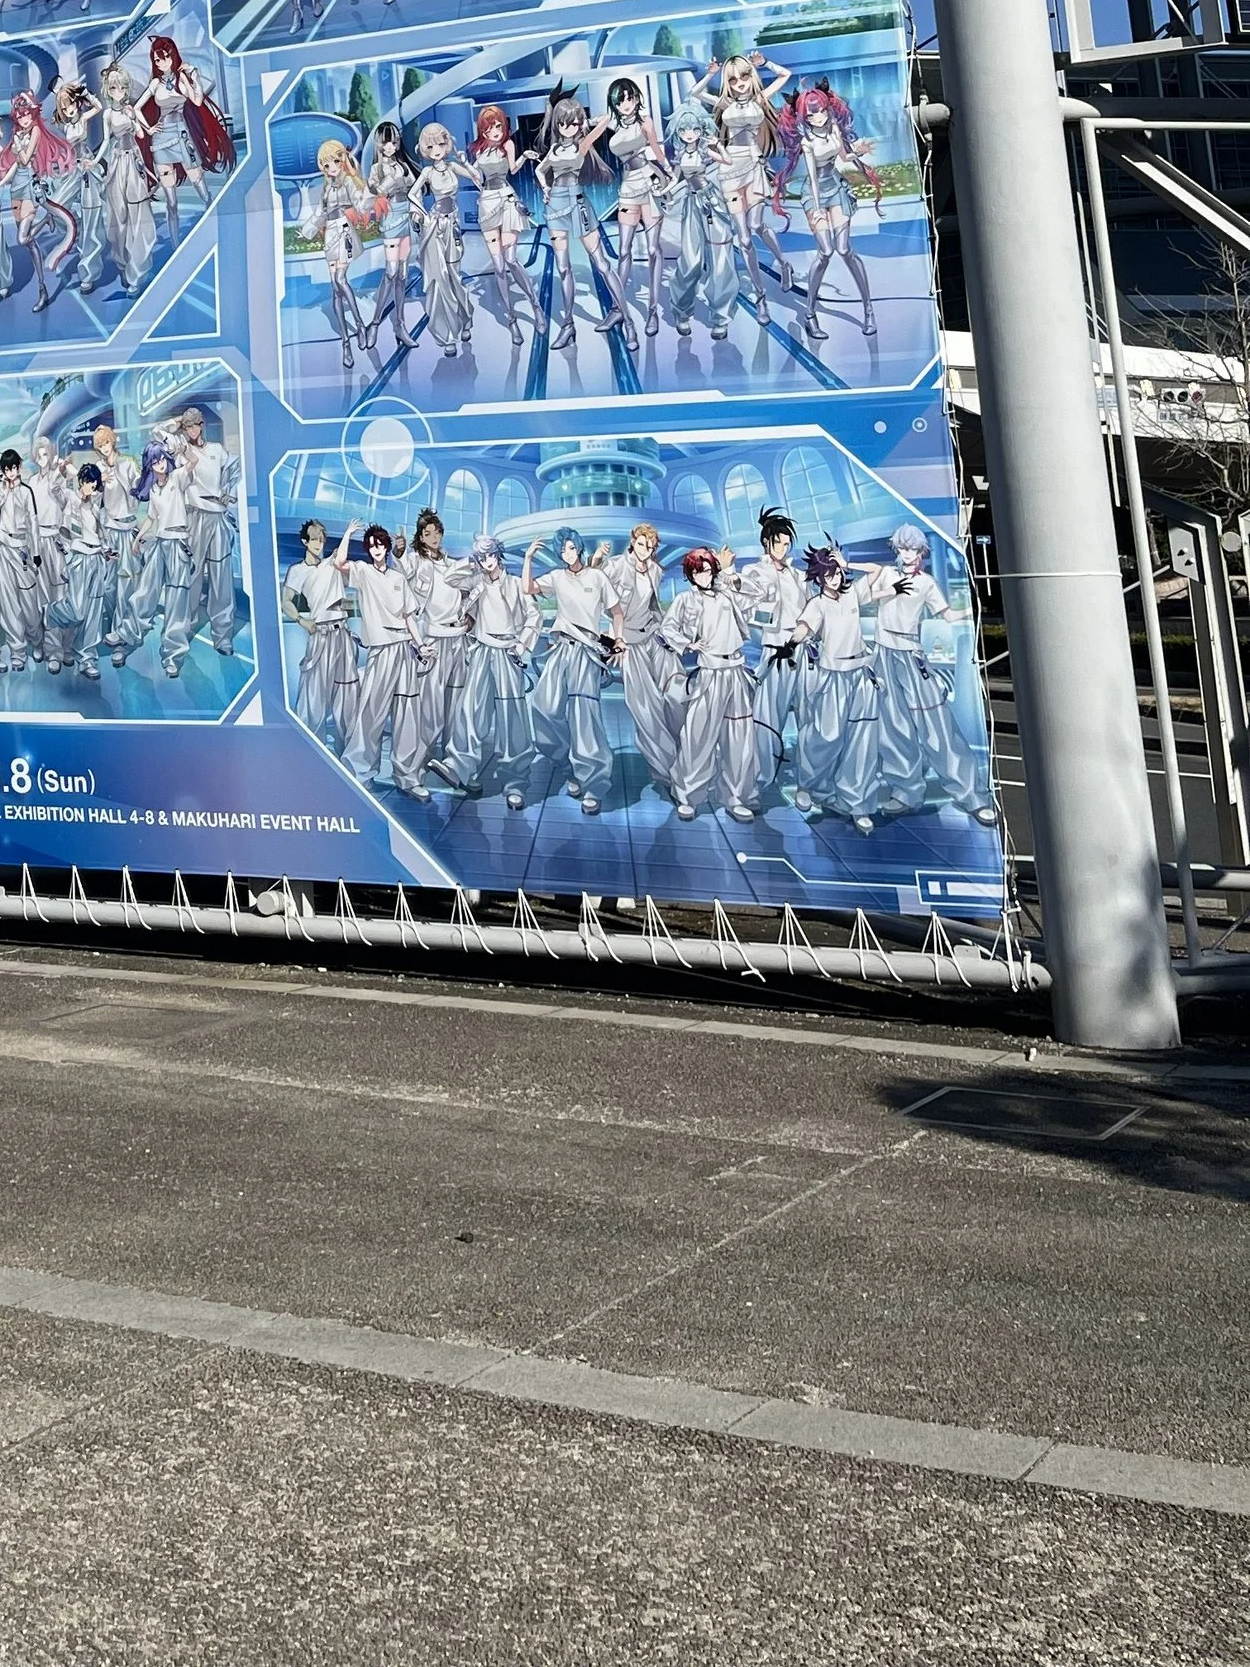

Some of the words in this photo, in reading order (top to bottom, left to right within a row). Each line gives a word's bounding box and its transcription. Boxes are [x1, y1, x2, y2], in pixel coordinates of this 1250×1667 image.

[37, 766, 95, 795] (Sun)
[4, 804, 85, 822] EXHIBITION
[88, 807, 126, 824] HALL
[130, 809, 154, 824] 4-8
[158, 810, 169, 825] &
[172, 812, 256, 829] MAKUHARI
[260, 814, 312, 831] EVENT
[317, 816, 360, 833] HALL
